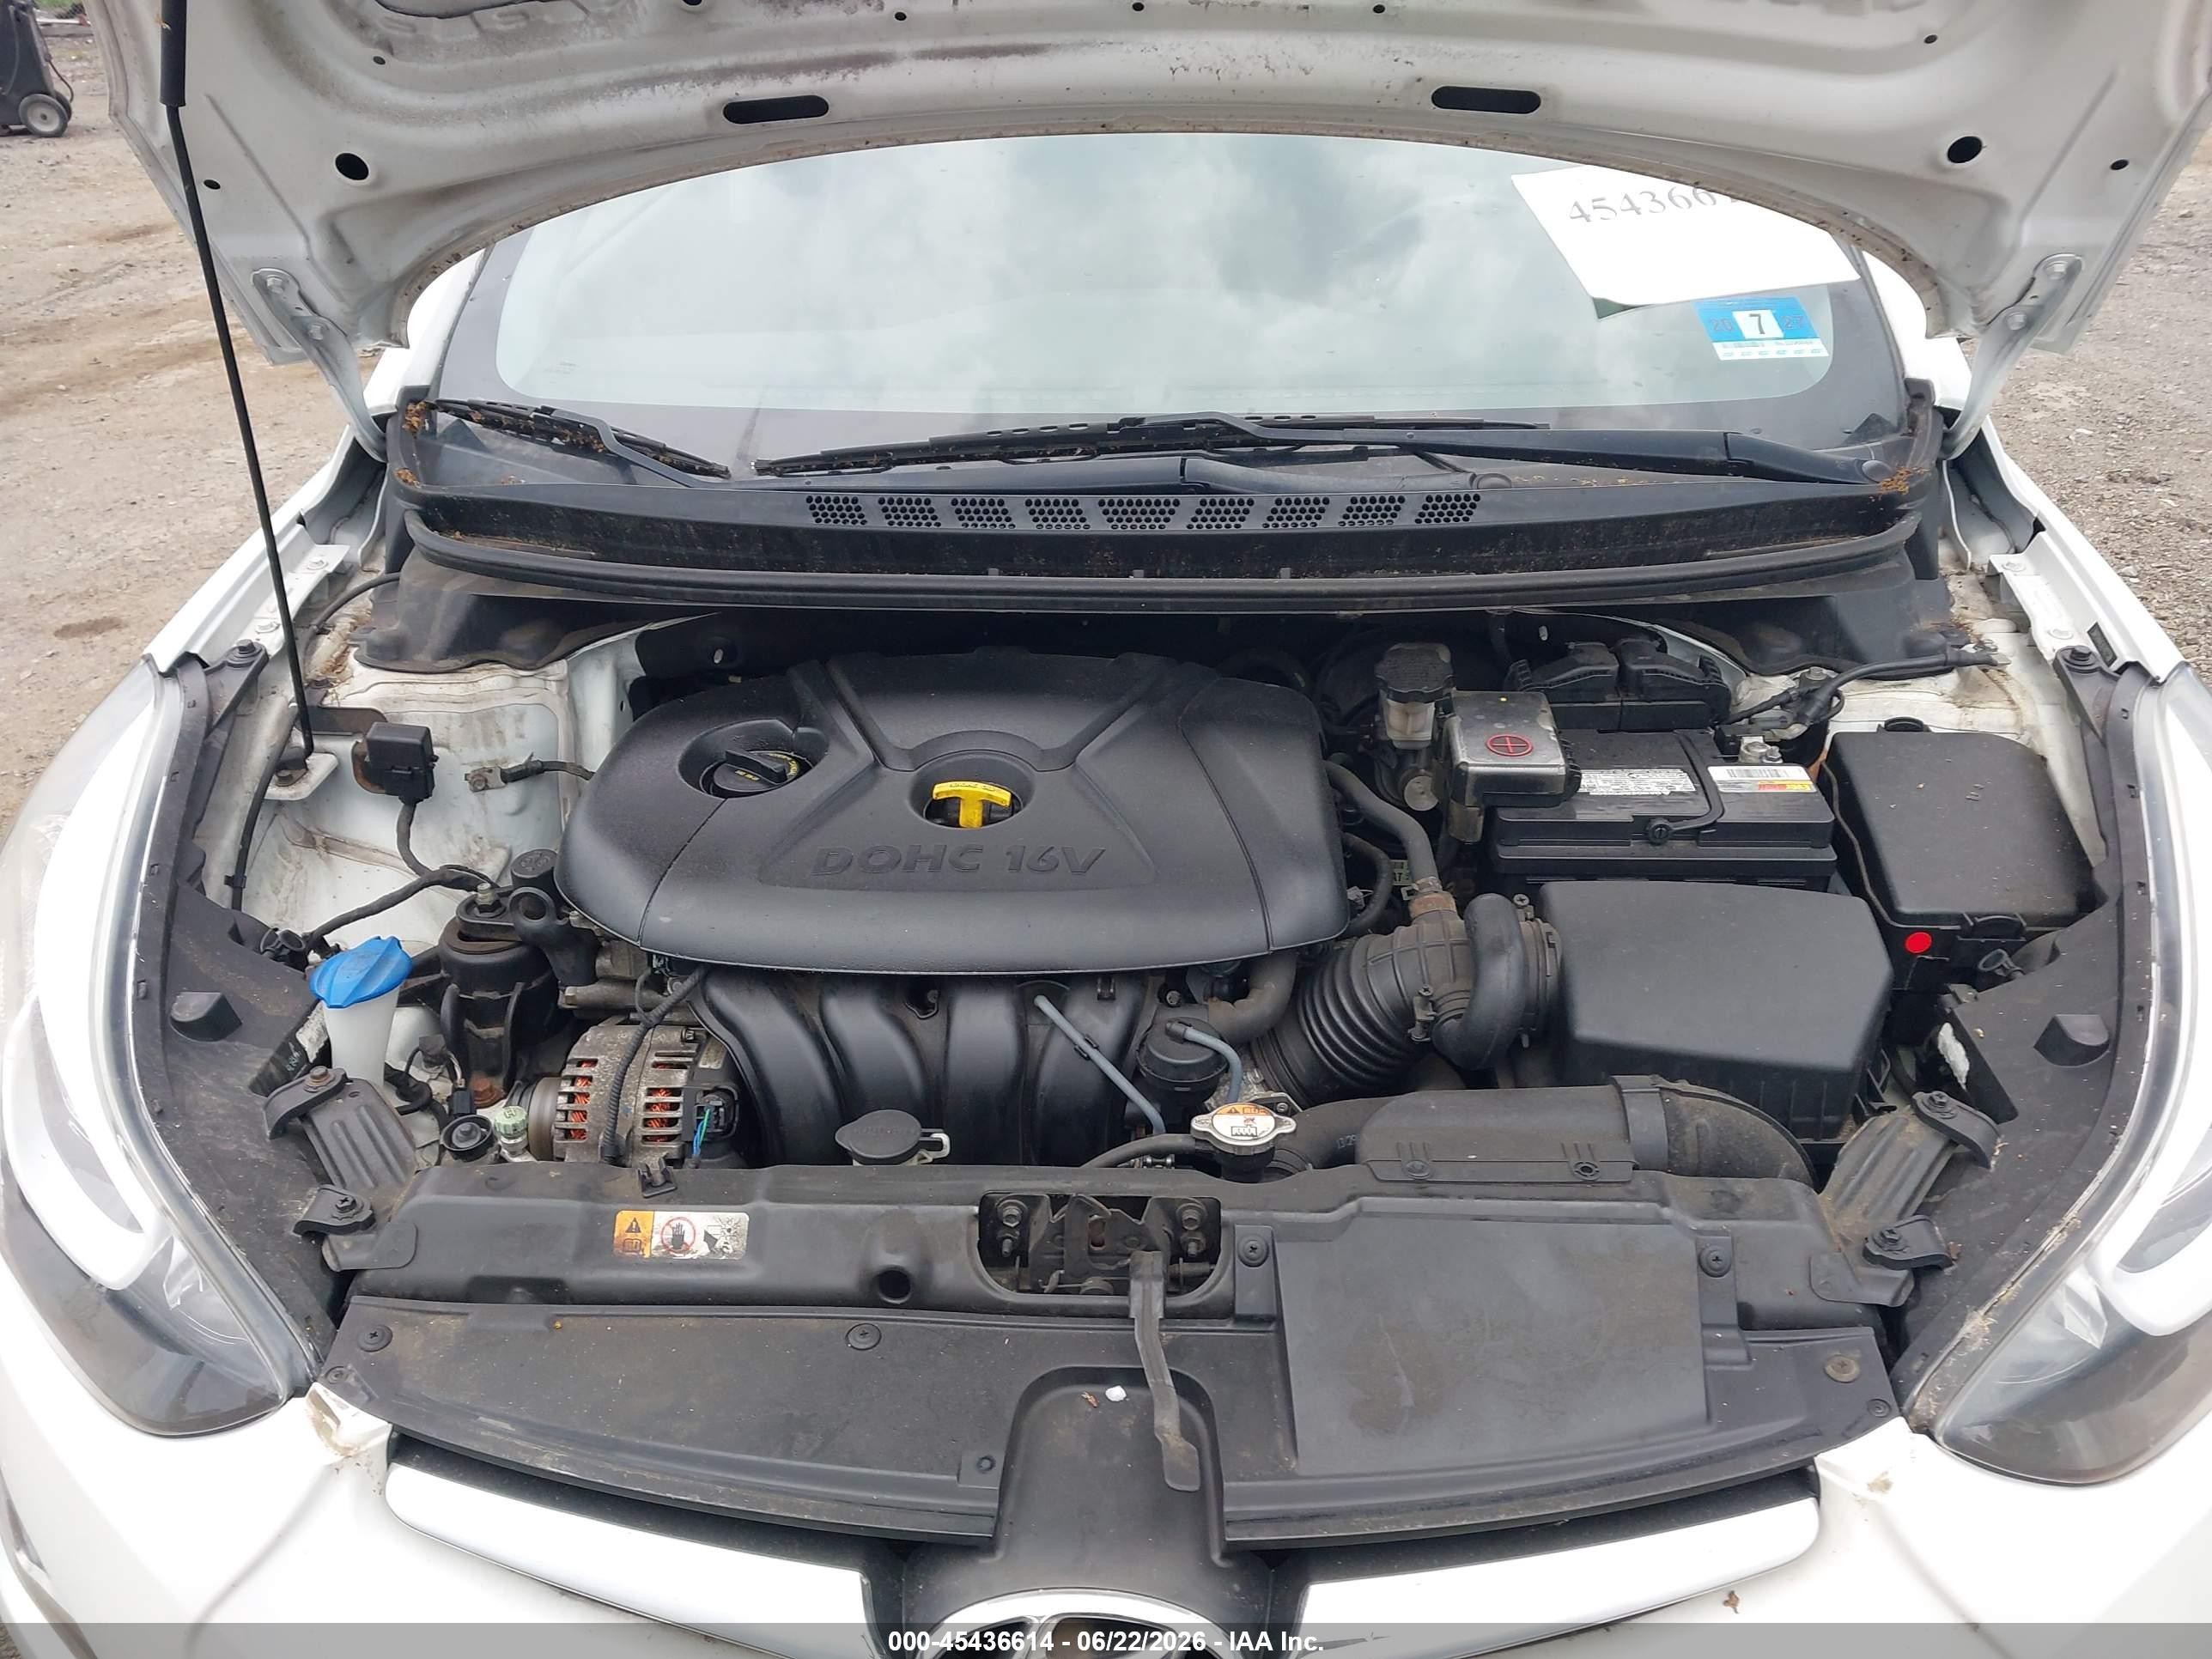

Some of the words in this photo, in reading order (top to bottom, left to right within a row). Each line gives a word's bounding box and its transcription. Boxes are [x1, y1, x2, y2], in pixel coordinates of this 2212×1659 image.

[1569, 185, 1738, 222] 454366
[1748, 313, 1765, 335] 7
[811, 844, 984, 876] DOHC
[1005, 845, 1107, 875] 16V
